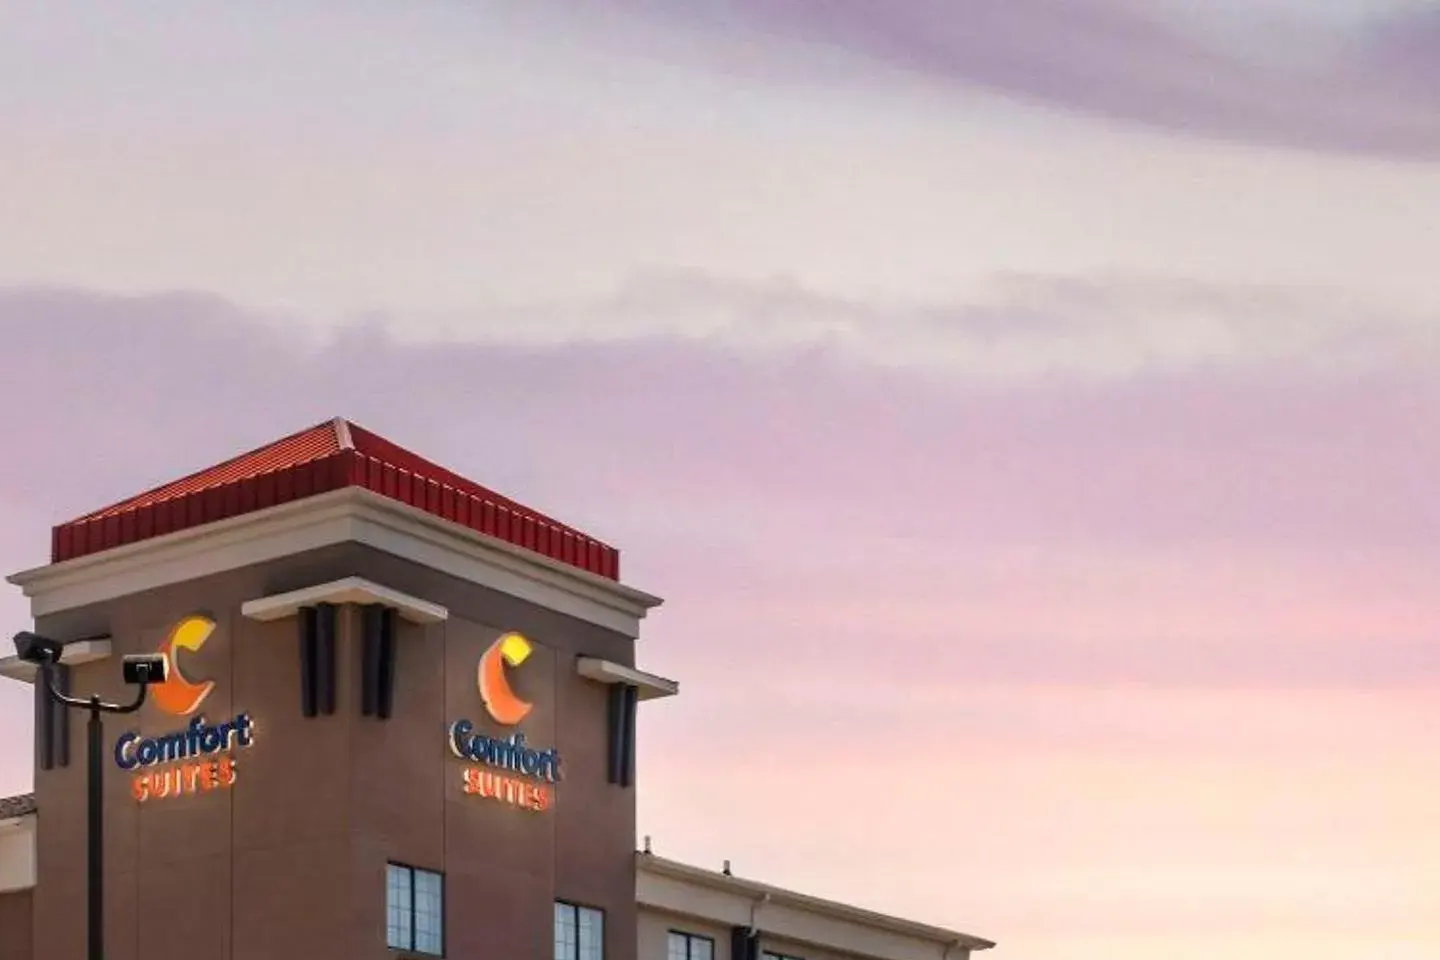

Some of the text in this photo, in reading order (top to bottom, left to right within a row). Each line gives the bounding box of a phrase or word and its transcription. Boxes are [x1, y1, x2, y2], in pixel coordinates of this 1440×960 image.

[115, 711, 255, 770] Comfort
[449, 719, 562, 784] Comfort
[132, 756, 237, 802] SUITES
[463, 767, 549, 812] SUITES
